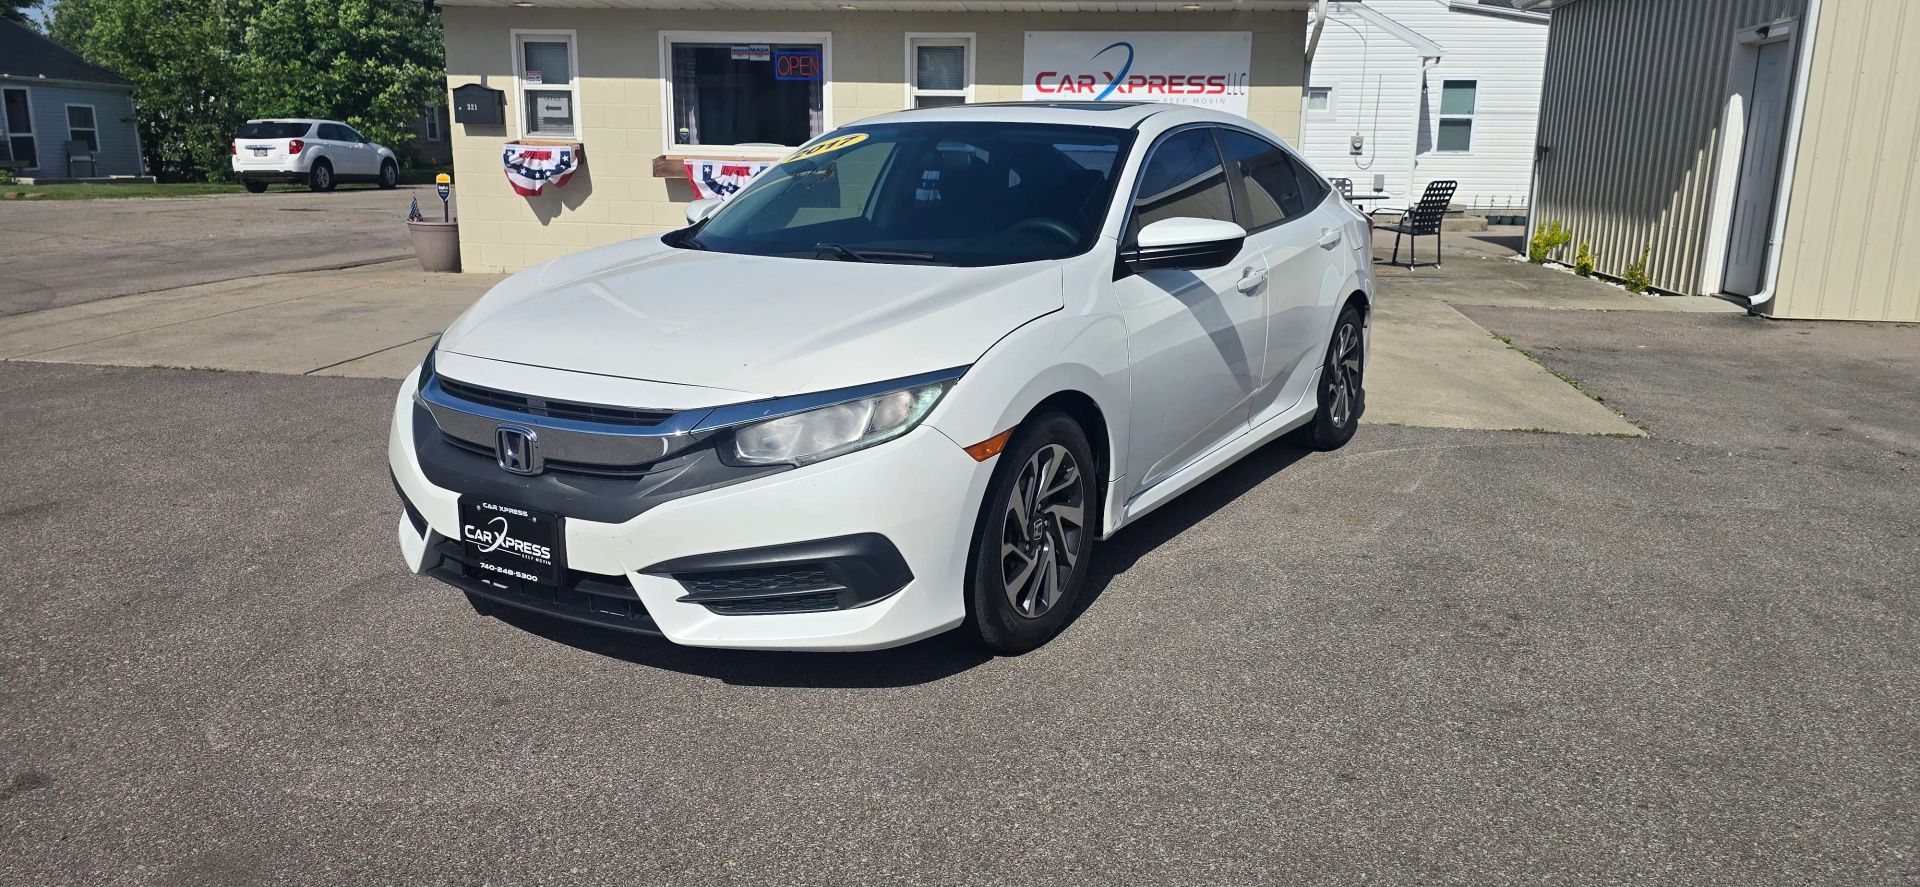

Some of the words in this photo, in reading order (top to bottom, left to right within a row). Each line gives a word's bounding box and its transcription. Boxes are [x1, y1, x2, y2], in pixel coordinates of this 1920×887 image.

[778, 56, 819, 76] OPEN
[1035, 71, 1096, 94] CAR
[1095, 68, 1226, 100] XPRESS
[1226, 72, 1247, 96] LLC
[788, 135, 861, 161] 2017
[482, 502, 498, 511] CAR
[499, 505, 528, 516] XPRESS
[464, 524, 493, 544] CAR
[486, 524, 550, 559] XPRESS
[480, 562, 538, 581] 740-248-5300
